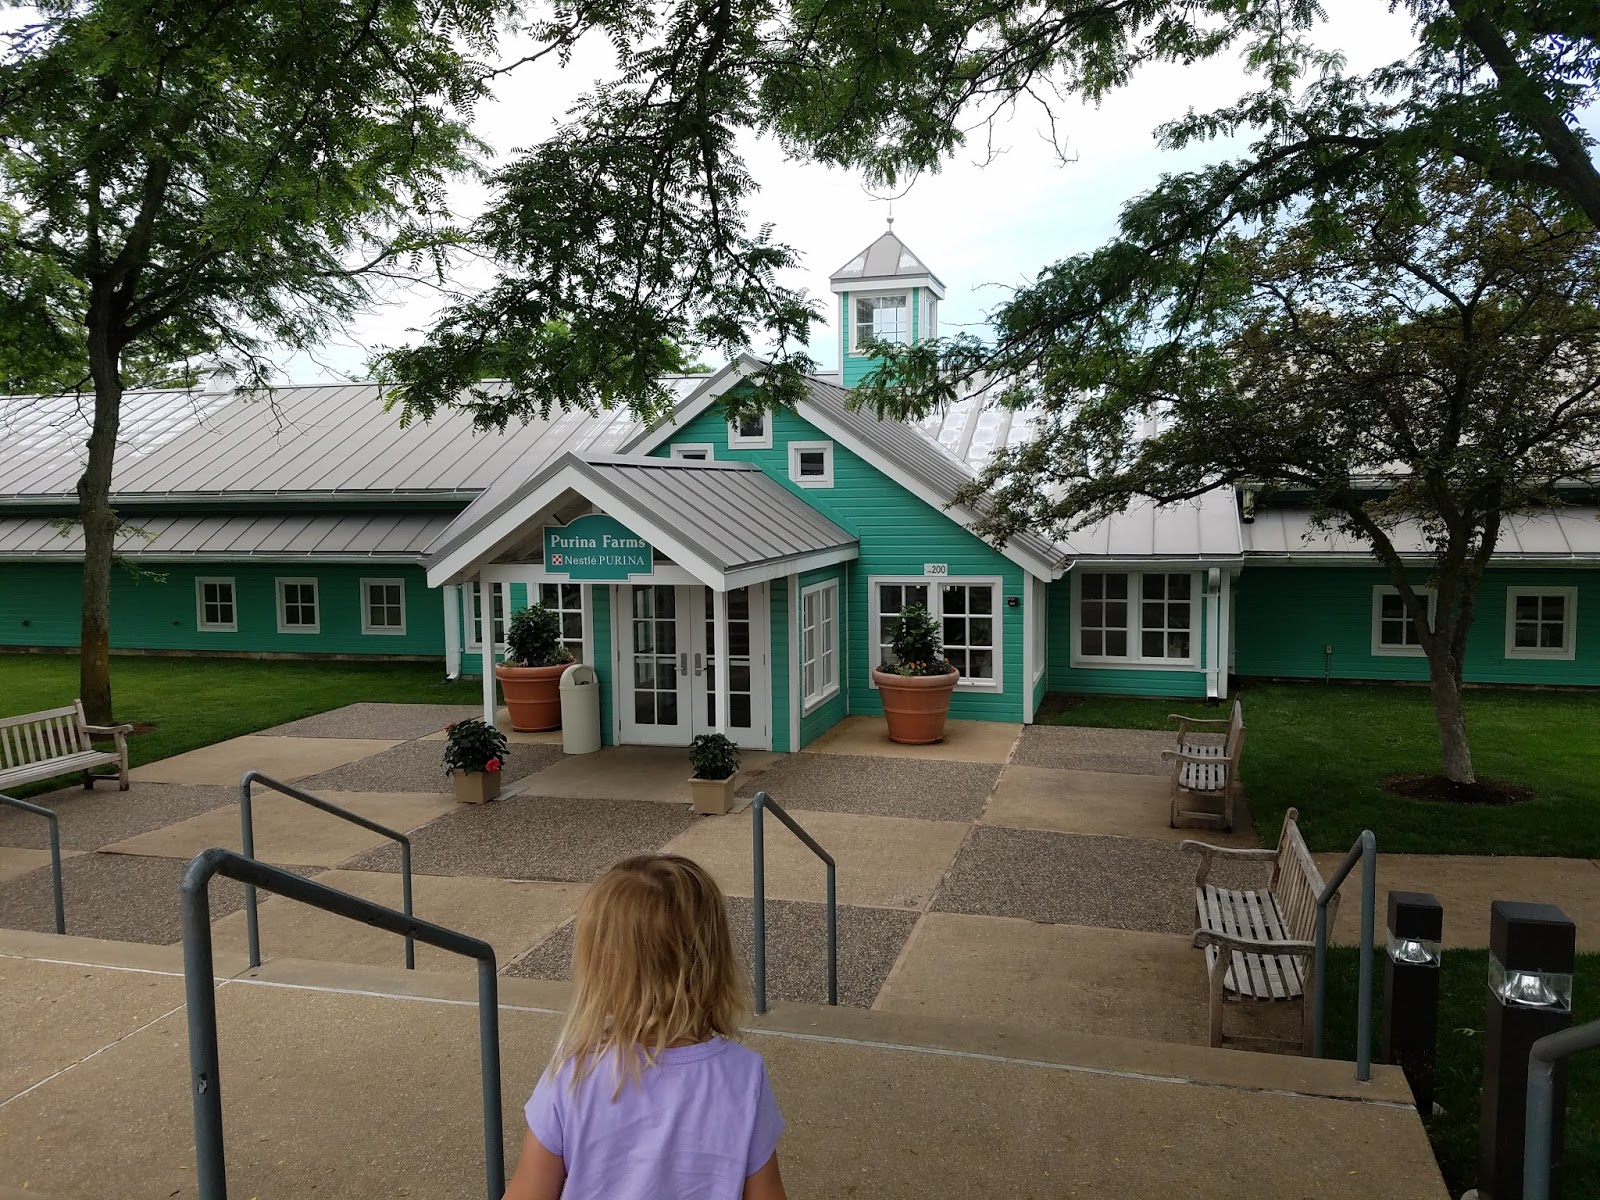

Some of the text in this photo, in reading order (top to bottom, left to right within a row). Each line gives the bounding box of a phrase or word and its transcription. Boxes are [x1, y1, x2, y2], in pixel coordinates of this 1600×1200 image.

[551, 535, 645, 548] Purina Farms
[564, 555, 644, 565] Nestlé PURINA
[932, 565, 945, 573] 200
